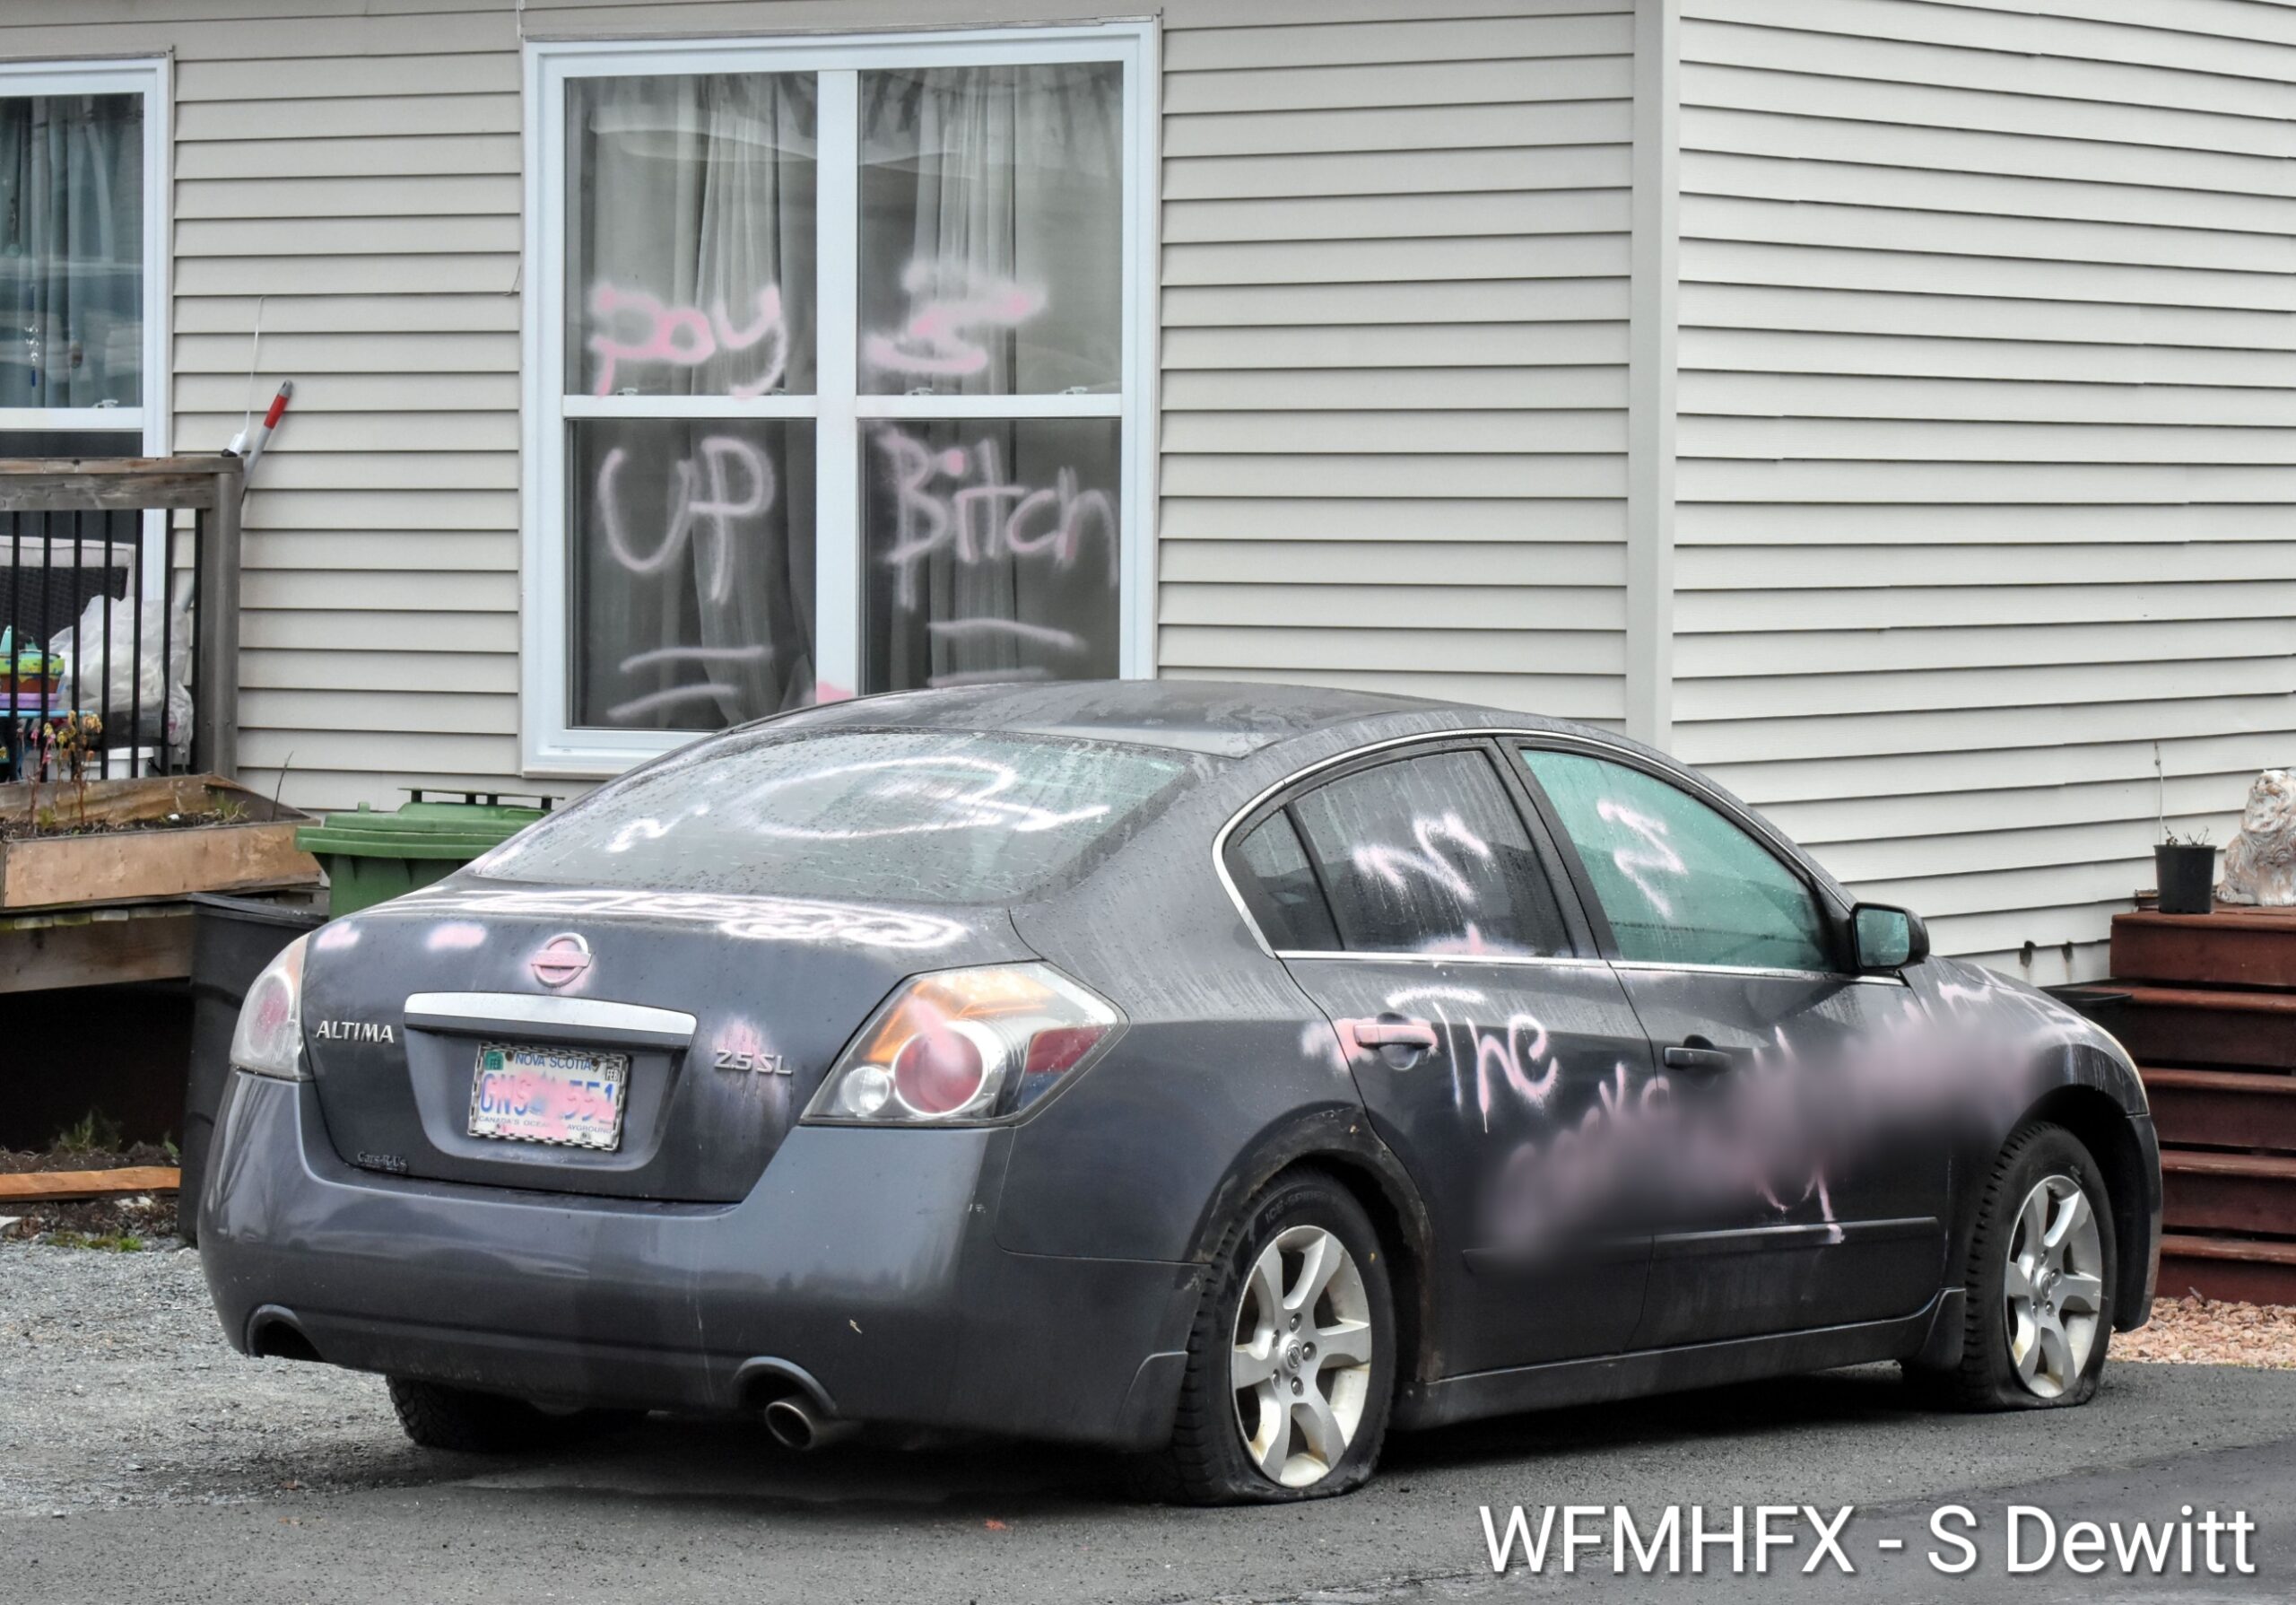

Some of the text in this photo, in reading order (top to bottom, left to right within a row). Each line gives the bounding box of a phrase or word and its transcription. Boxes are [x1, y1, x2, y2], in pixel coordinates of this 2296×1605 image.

[874, 423, 1118, 612] Bitch
[316, 1020, 395, 1043] ALTIMA
[515, 1052, 592, 1071] NOVA SCOTIA
[714, 1049, 793, 1075] 2.5 SL
[1387, 986, 1559, 1130] The
[606, 1069, 619, 1080] FEB
